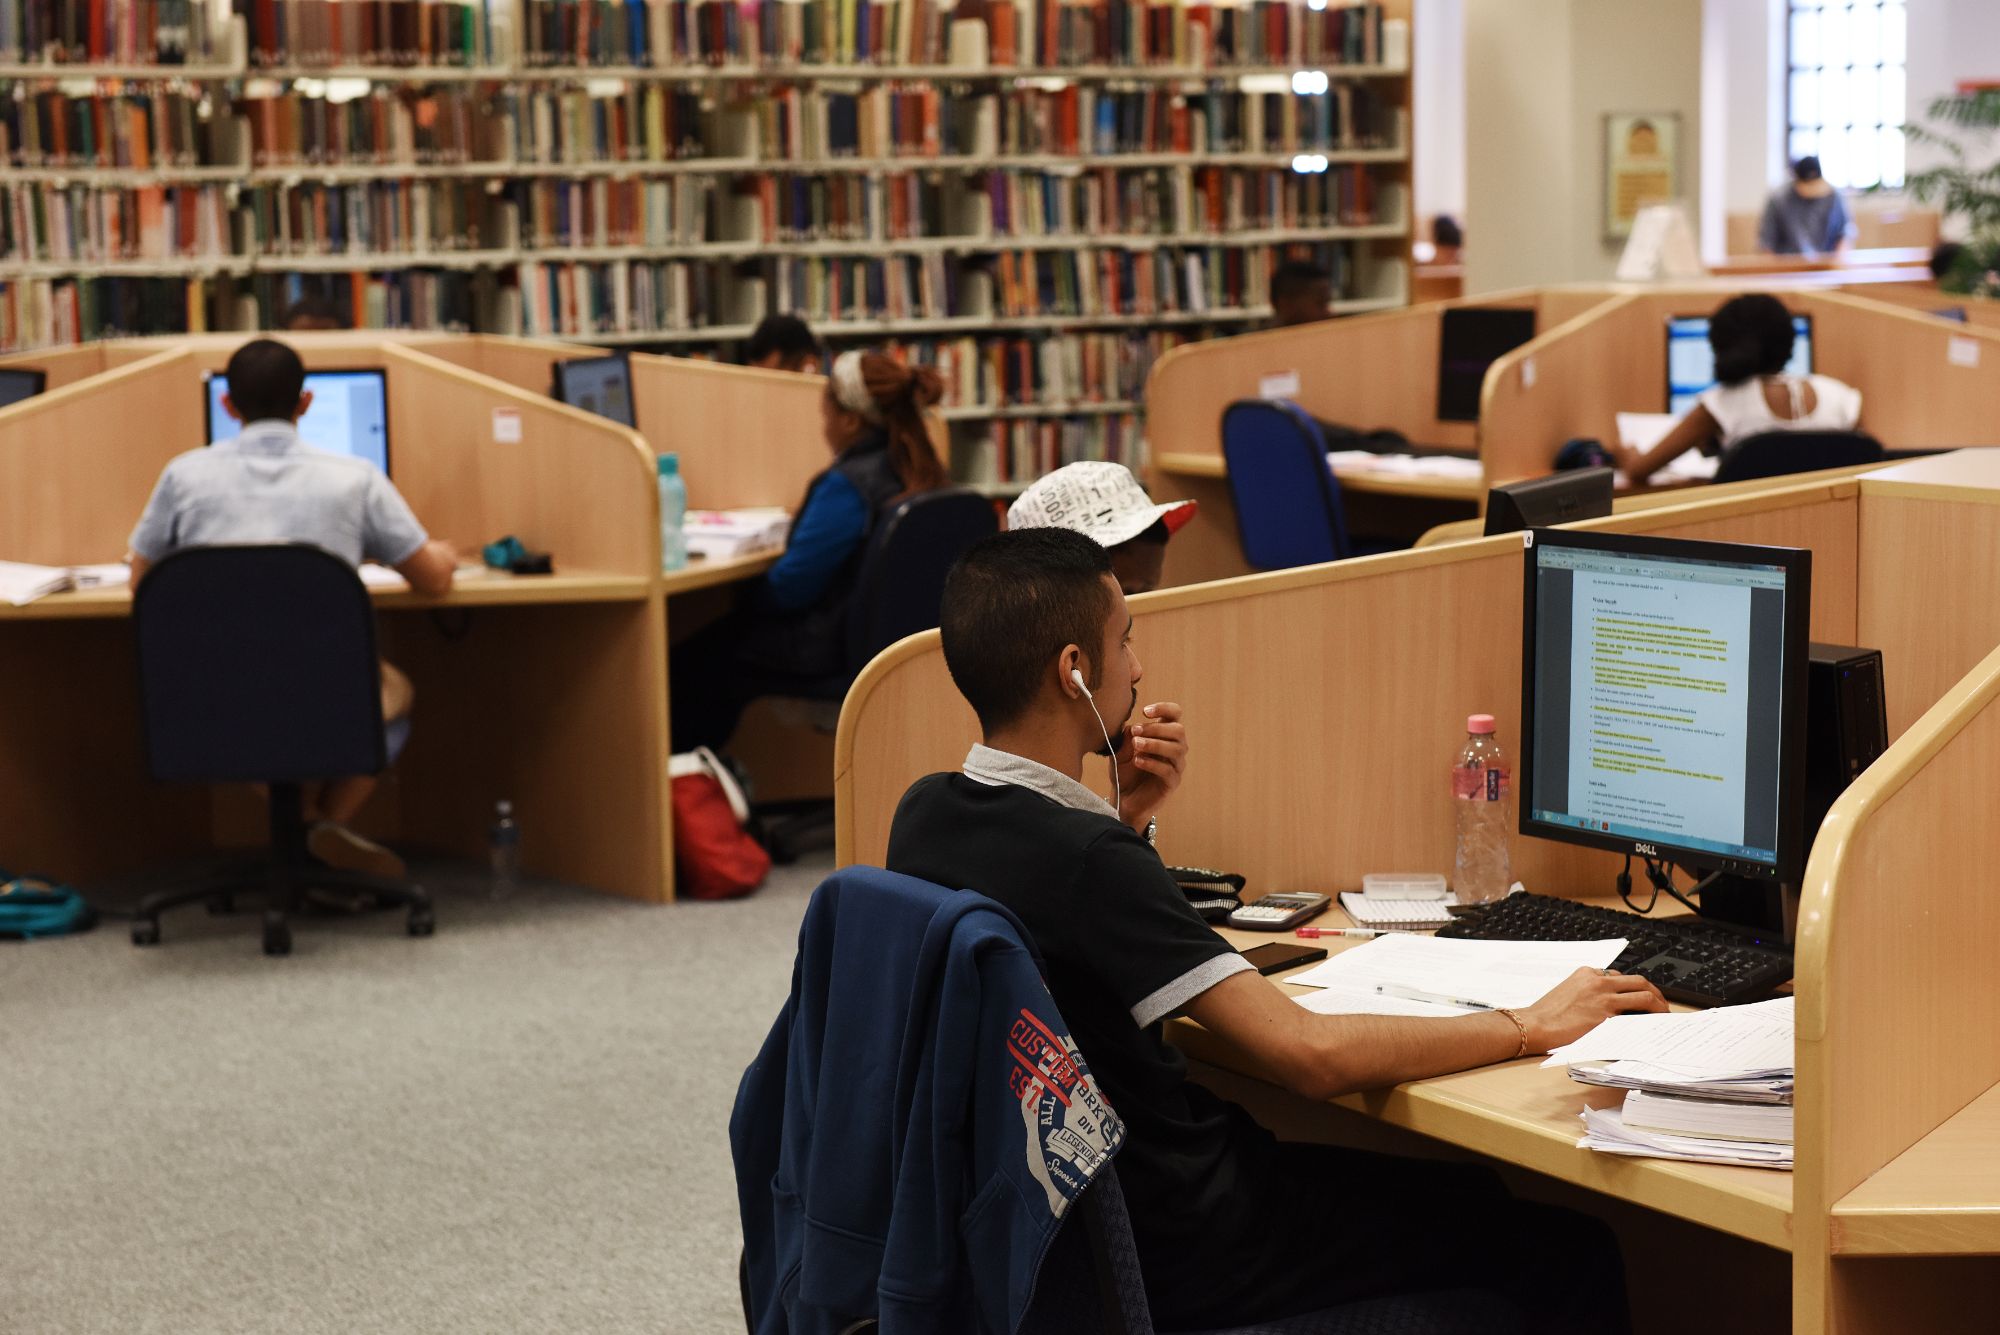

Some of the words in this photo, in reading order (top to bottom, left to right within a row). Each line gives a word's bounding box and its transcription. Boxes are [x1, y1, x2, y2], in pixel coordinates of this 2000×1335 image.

[1635, 842, 1657, 856] DELL
[1010, 1019, 1077, 1089] CUSTOM
[1041, 1096, 1057, 1126] ALL
[1077, 1115, 1096, 1135] DIV
